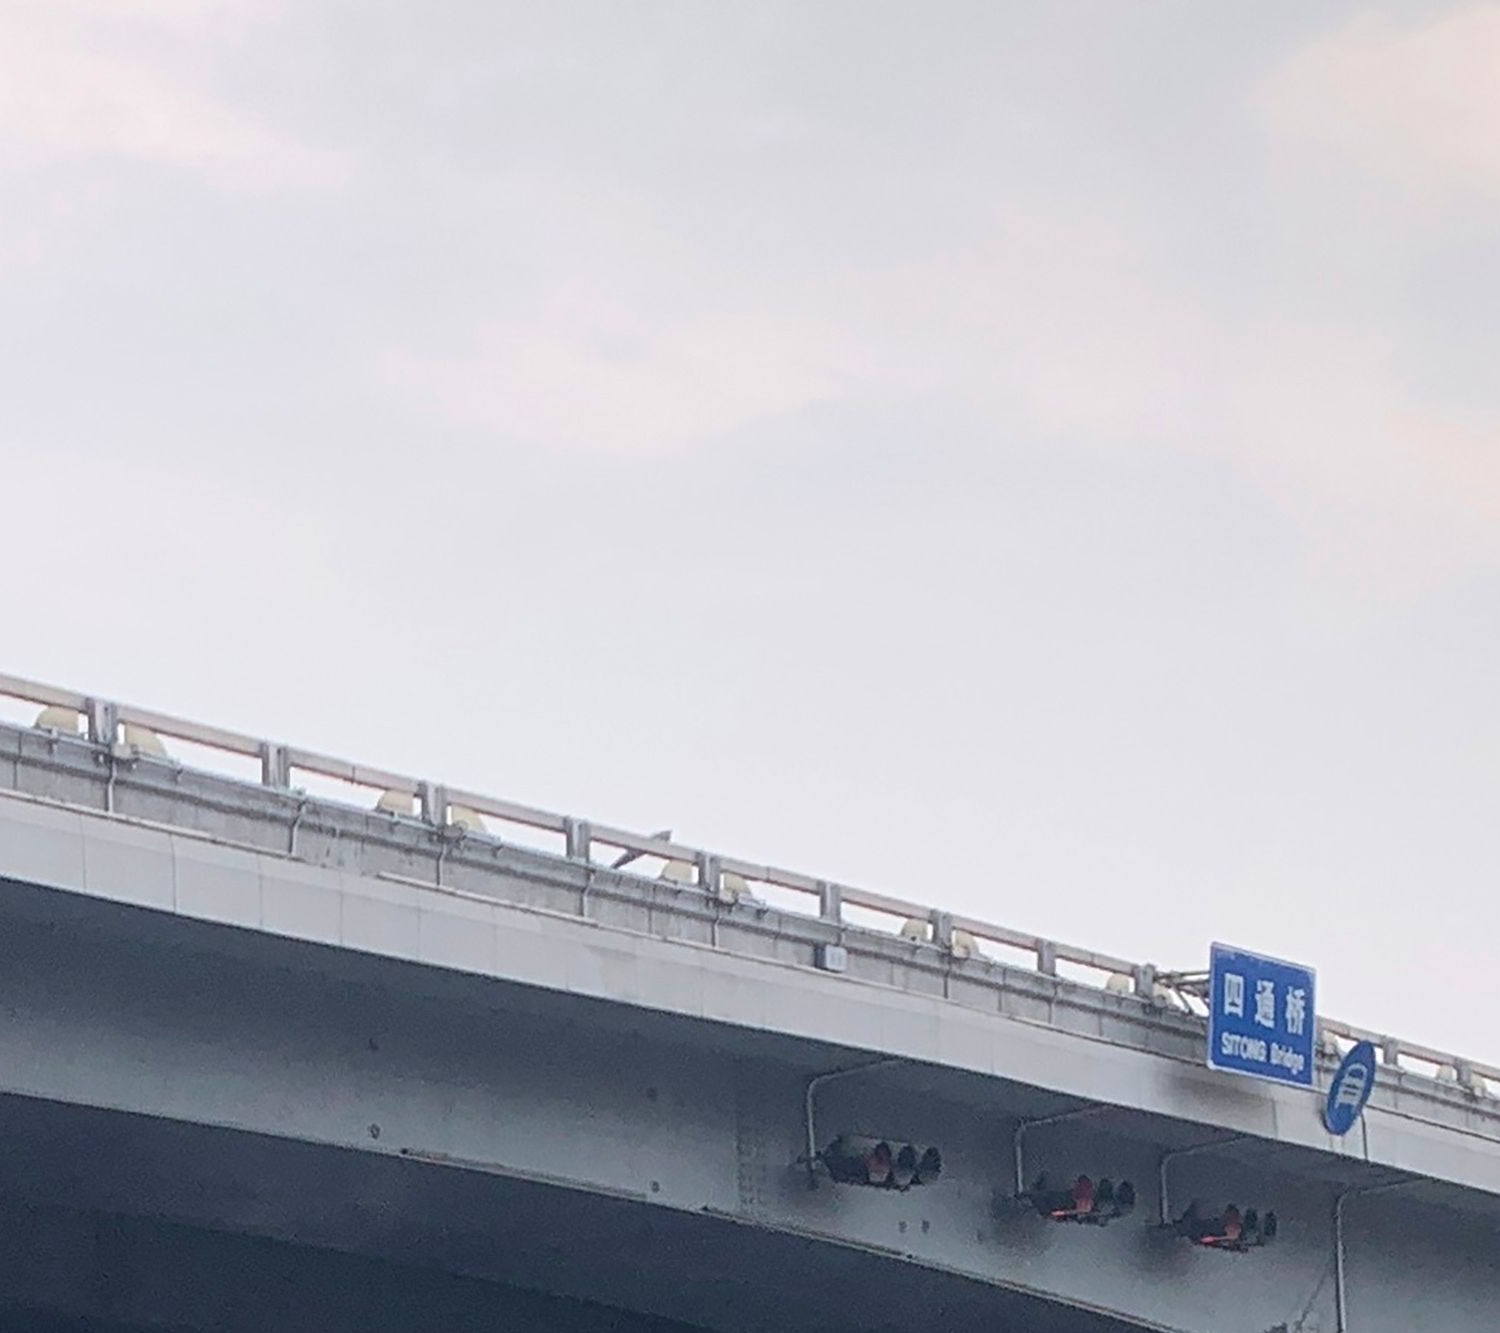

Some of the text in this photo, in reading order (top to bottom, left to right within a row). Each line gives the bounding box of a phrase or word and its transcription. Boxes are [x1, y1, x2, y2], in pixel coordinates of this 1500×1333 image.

[1224, 972, 1305, 1035] 四通桥
[1221, 1031, 1305, 1075] SITONG Bridge
